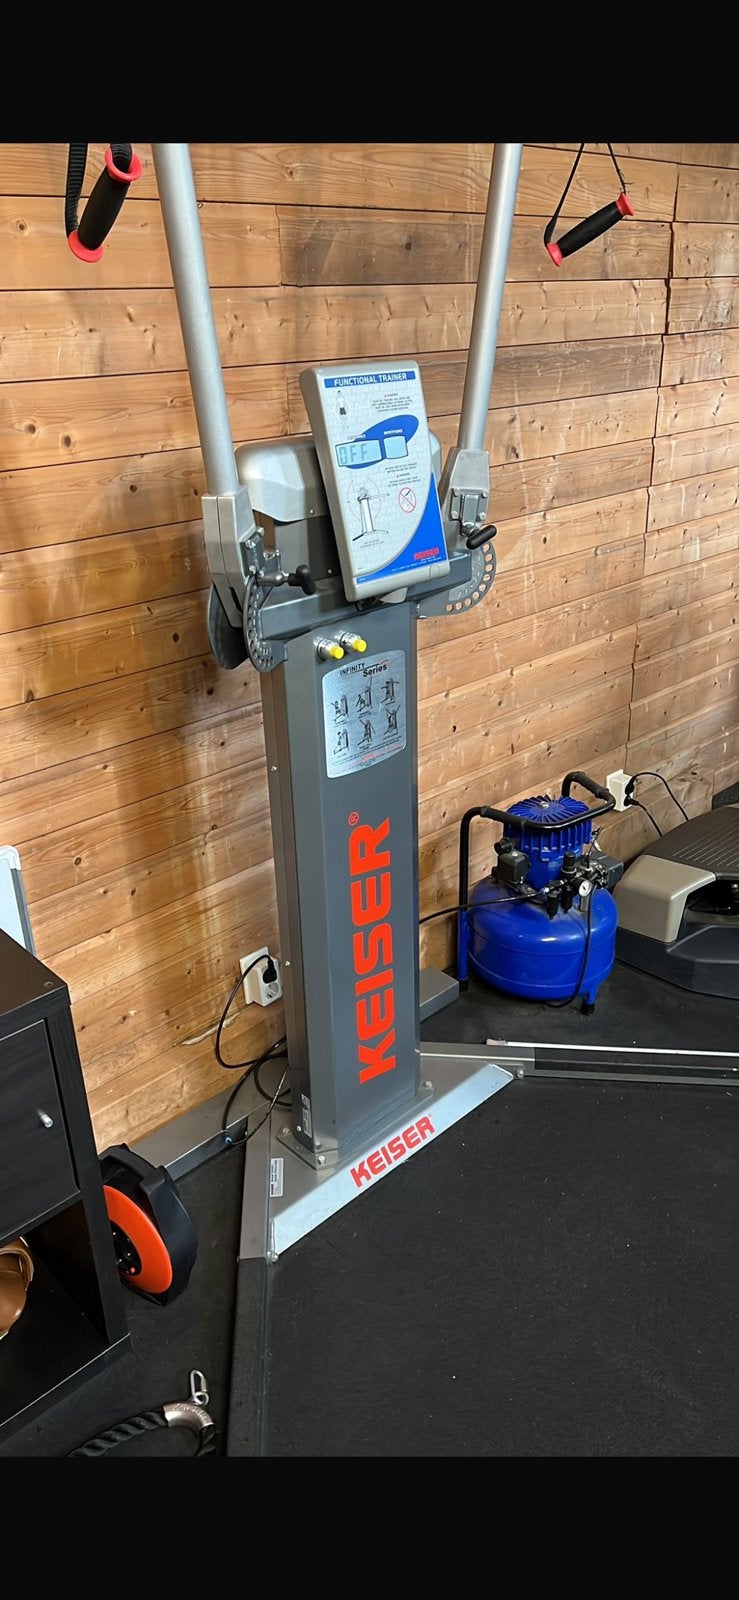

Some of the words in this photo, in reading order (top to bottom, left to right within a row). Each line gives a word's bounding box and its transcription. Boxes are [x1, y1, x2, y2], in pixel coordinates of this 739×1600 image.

[334, 376, 377, 387] FUNCTIONAL
[378, 372, 407, 382] TRAINER
[339, 443, 367, 465] OFF
[340, 662, 365, 676] INFINITY
[363, 664, 387, 677] Series
